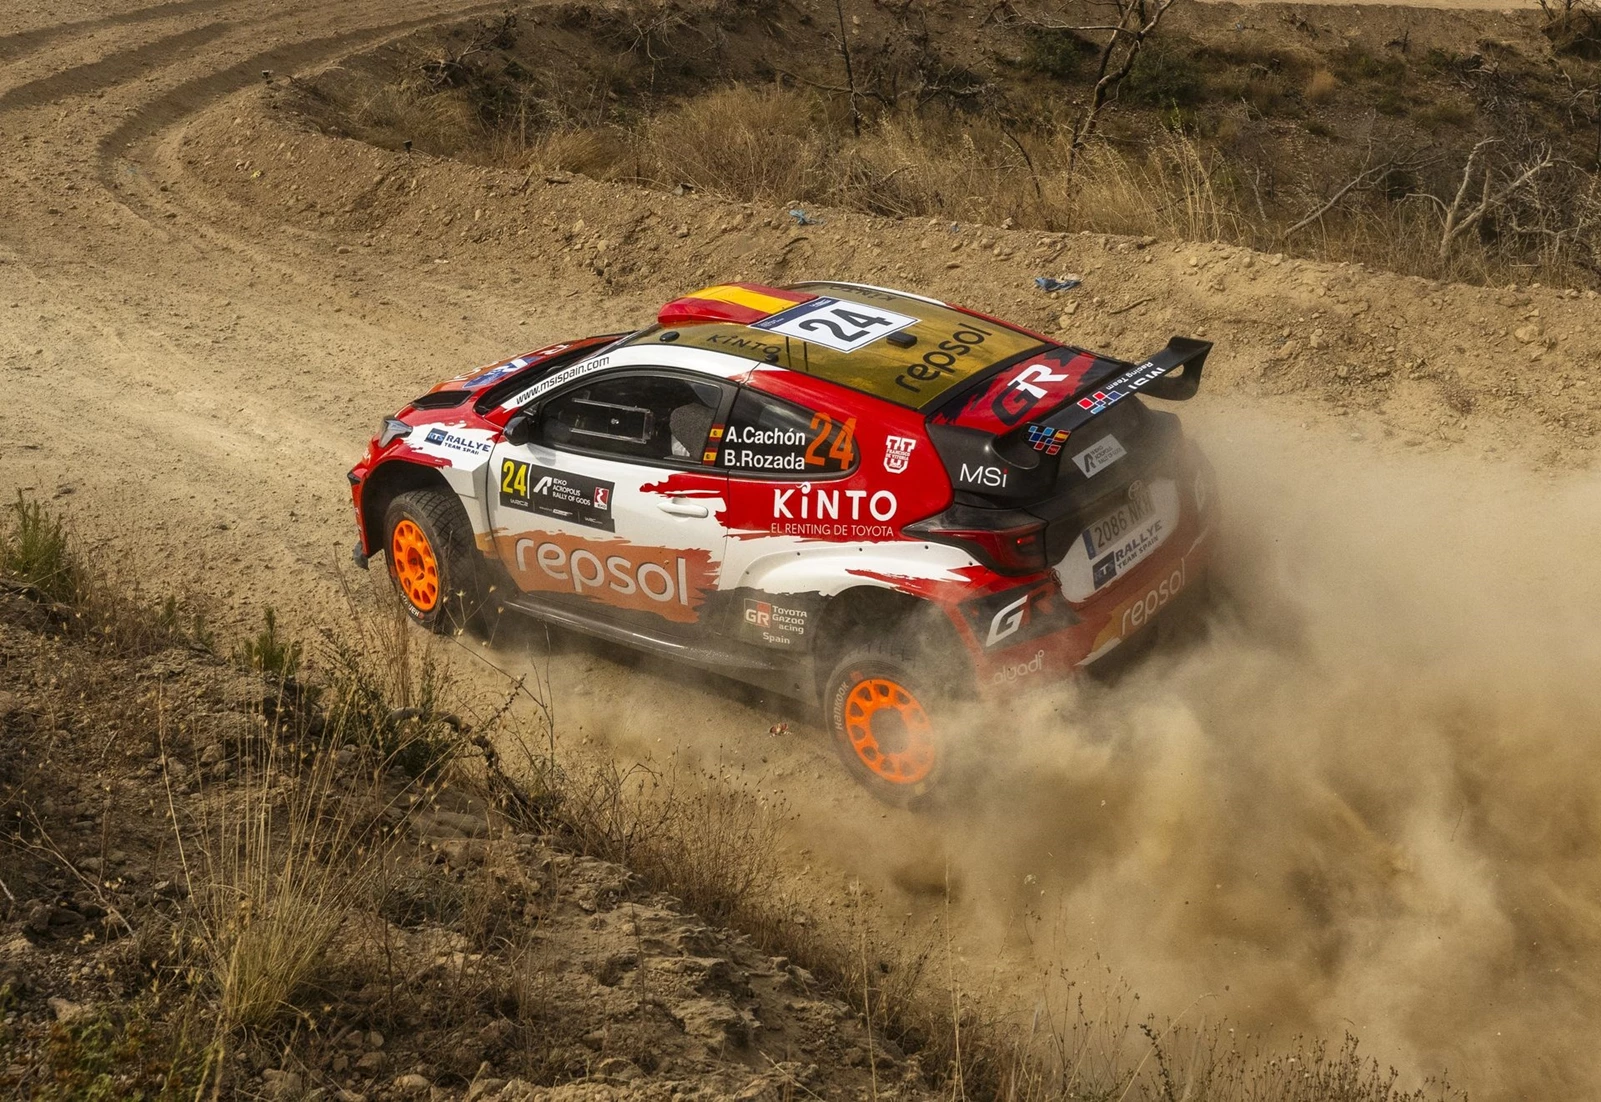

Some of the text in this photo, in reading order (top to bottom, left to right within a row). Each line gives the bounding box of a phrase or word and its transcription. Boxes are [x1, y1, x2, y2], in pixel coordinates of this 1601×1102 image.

[799, 308, 893, 342] 24
[895, 323, 993, 393] repsol
[516, 356, 610, 405] www.msispain.com
[991, 364, 1069, 426] GR
[444, 442, 461, 450] TEAM
[446, 434, 491, 452] RALLYE
[725, 412, 857, 470] A.Cachón 24
[724, 449, 805, 470] B.Rozada
[502, 460, 527, 496] 24
[959, 463, 1008, 488] MSi
[552, 485, 581, 496] ACROPOLIS
[552, 491, 567, 500] RALLY
[575, 497, 591, 506] GODS
[771, 522, 894, 537] EL RENTING DE TOYOTA
[1094, 510, 1128, 549] 2086
[1115, 519, 1163, 562] RALLYE
[1117, 551, 1138, 569] TEAM
[515, 537, 688, 606] repsol
[1121, 557, 1186, 636] repsol
[745, 608, 770, 626] GR
[772, 605, 808, 618] TOYOTA
[772, 613, 805, 625] GAZOO
[762, 631, 791, 645] Spain
[777, 623, 805, 635] acing
